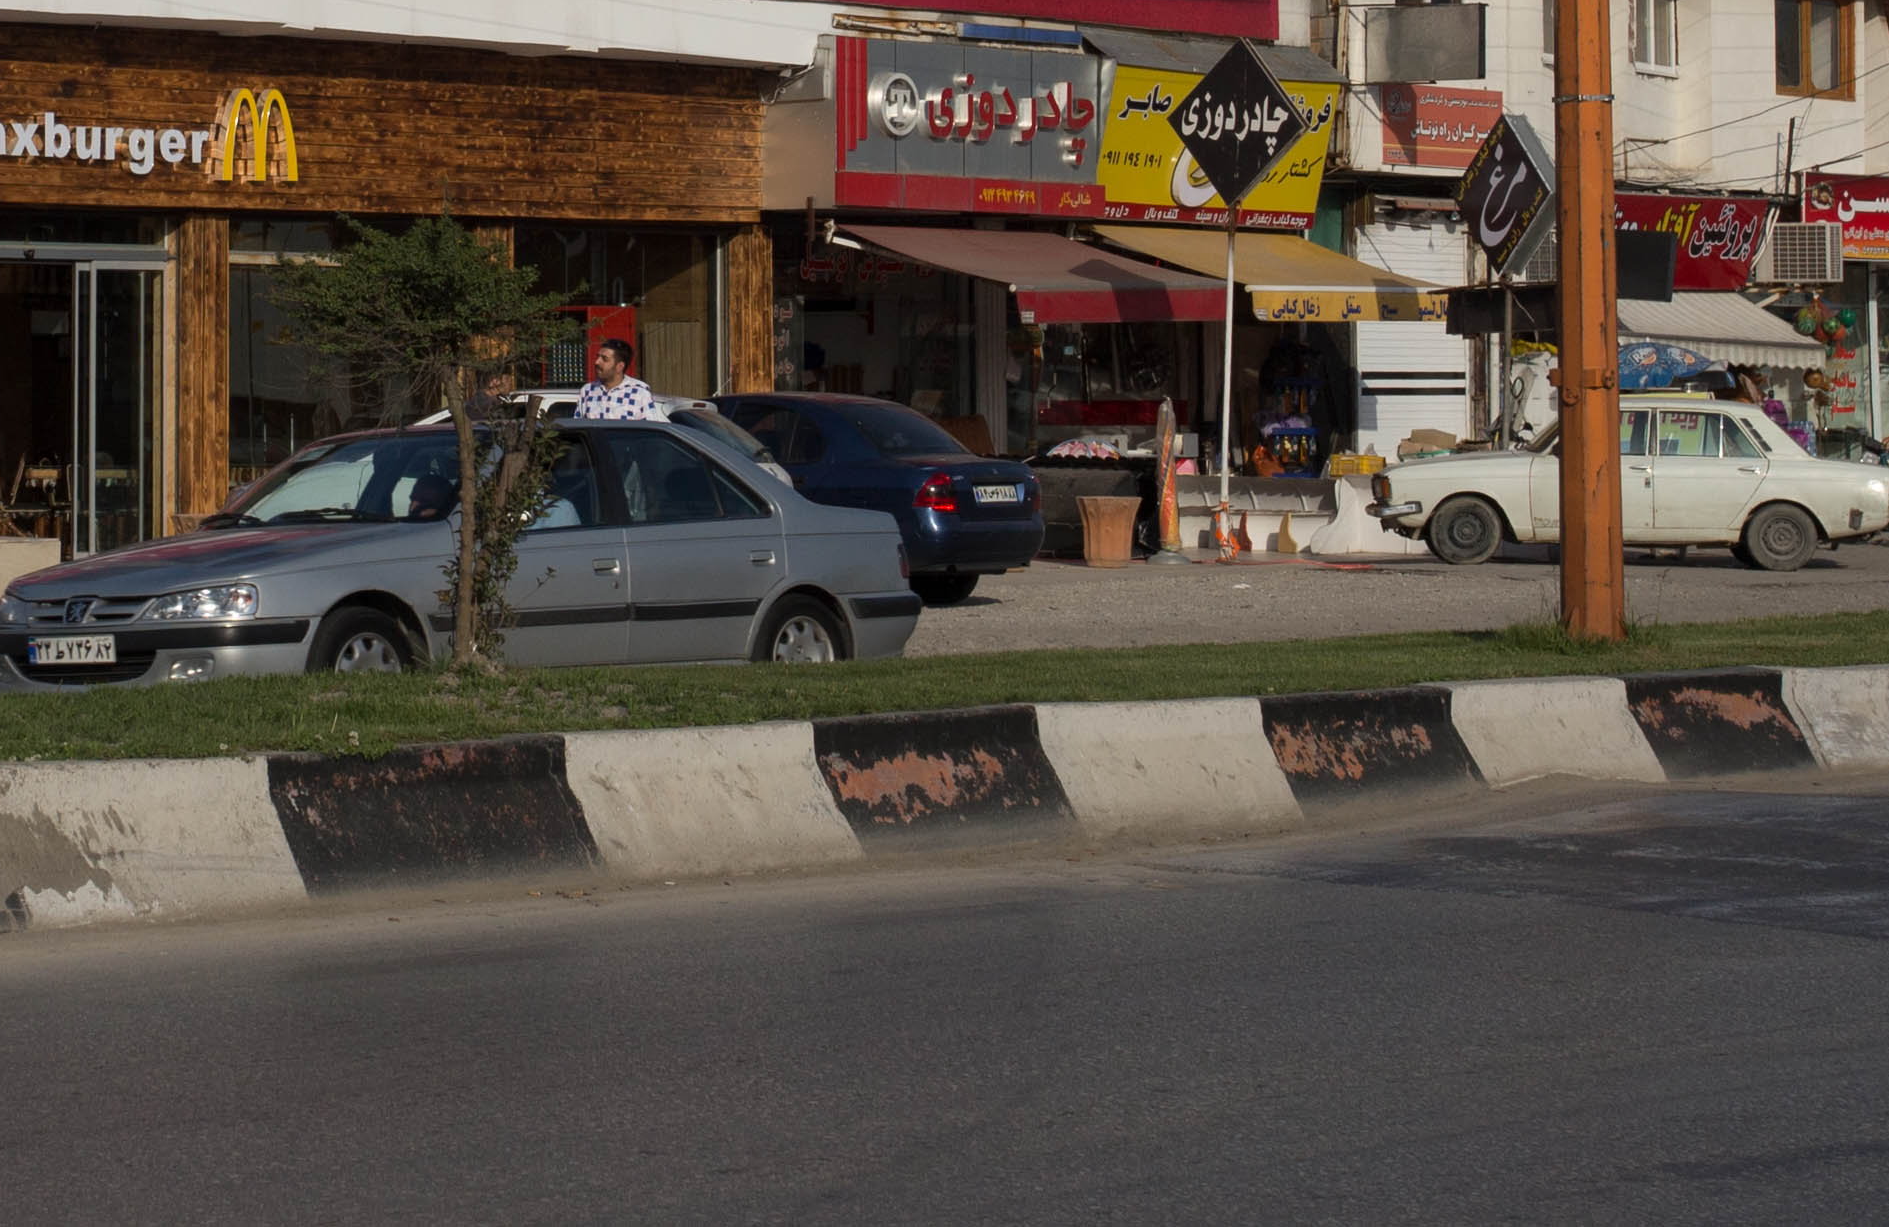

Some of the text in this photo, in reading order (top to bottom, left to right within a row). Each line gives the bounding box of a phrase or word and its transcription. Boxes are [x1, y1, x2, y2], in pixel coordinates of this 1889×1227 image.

[1118, 84, 1172, 119] صابر
[1479, 143, 1528, 248] مرغ
[1688, 203, 1759, 262] پروتئین
[1298, 296, 1321, 320] زغال
